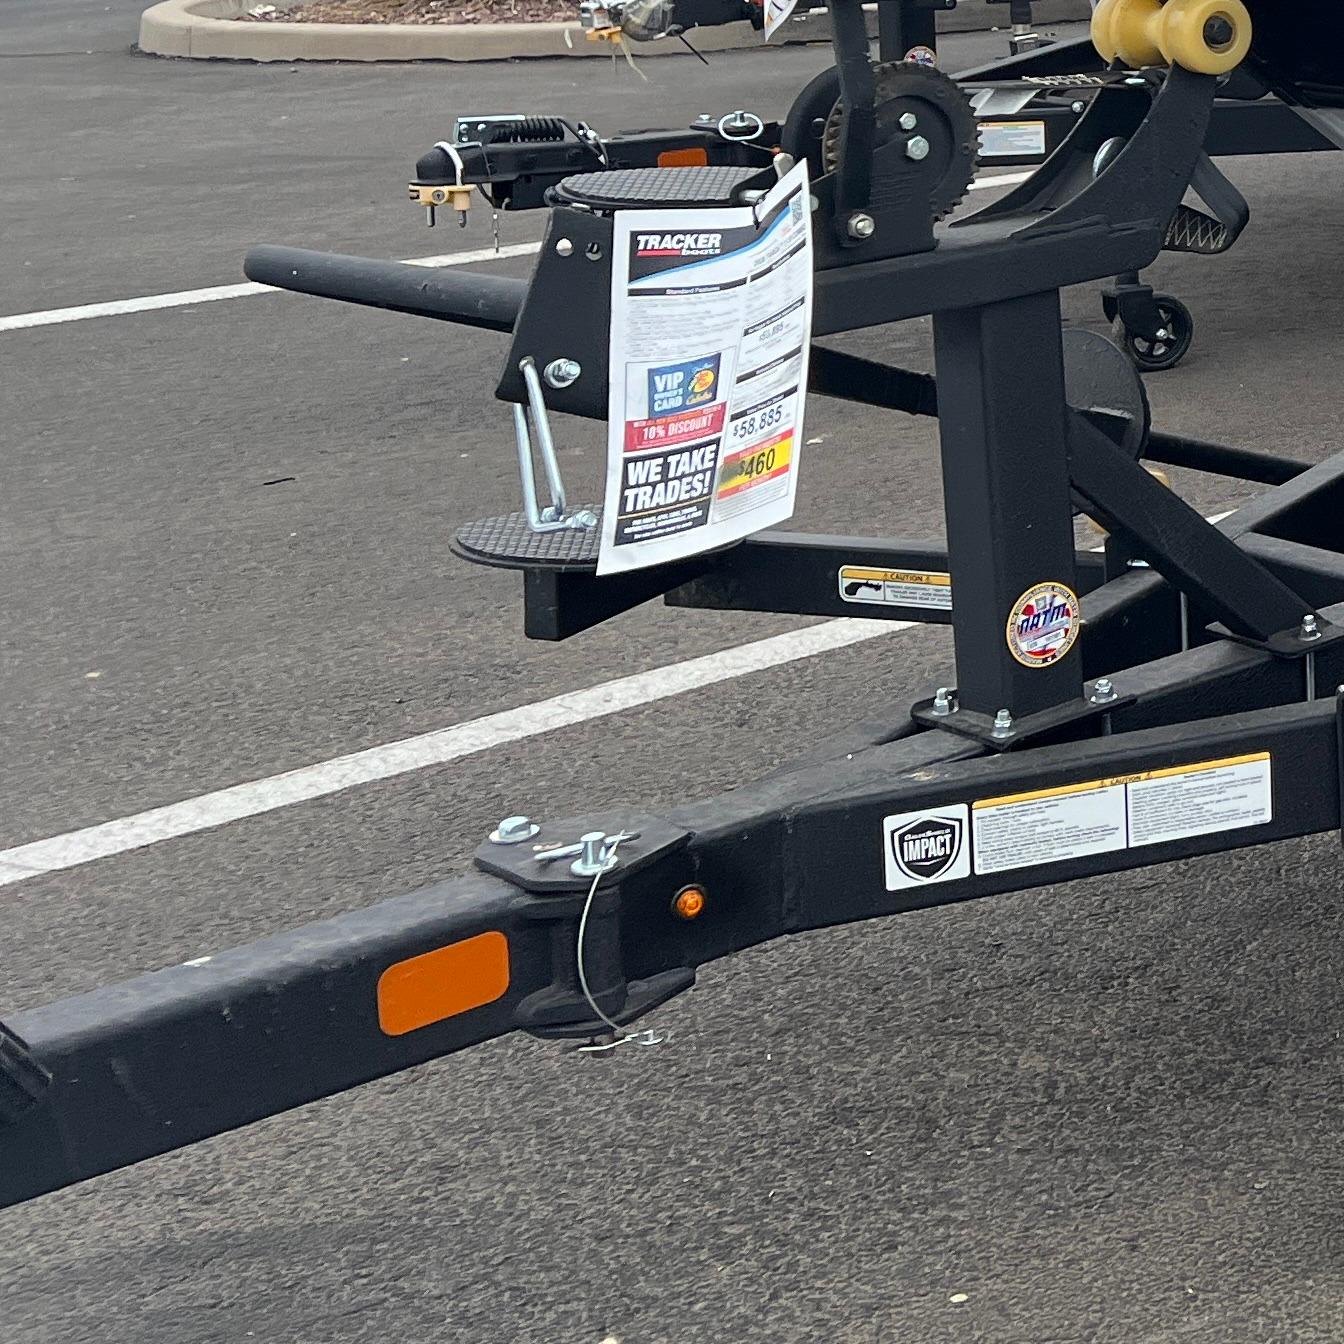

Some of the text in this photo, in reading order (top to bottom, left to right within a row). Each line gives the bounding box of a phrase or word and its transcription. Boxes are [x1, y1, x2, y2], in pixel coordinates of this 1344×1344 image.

[636, 233, 722, 251] TRACKER
[681, 248, 721, 256] boats
[654, 371, 684, 393] VIP
[654, 396, 683, 413] CARD
[643, 425, 666, 441] 10%
[667, 413, 714, 437] DISCOUNT
[627, 457, 664, 487] WE
[667, 444, 717, 479] TAKE
[737, 448, 776, 479] $460
[624, 470, 712, 513] TRADES!
[890, 572, 924, 582] CAUTION
[1110, 775, 1142, 785] CAUTION
[902, 833, 953, 863] IMPACT
